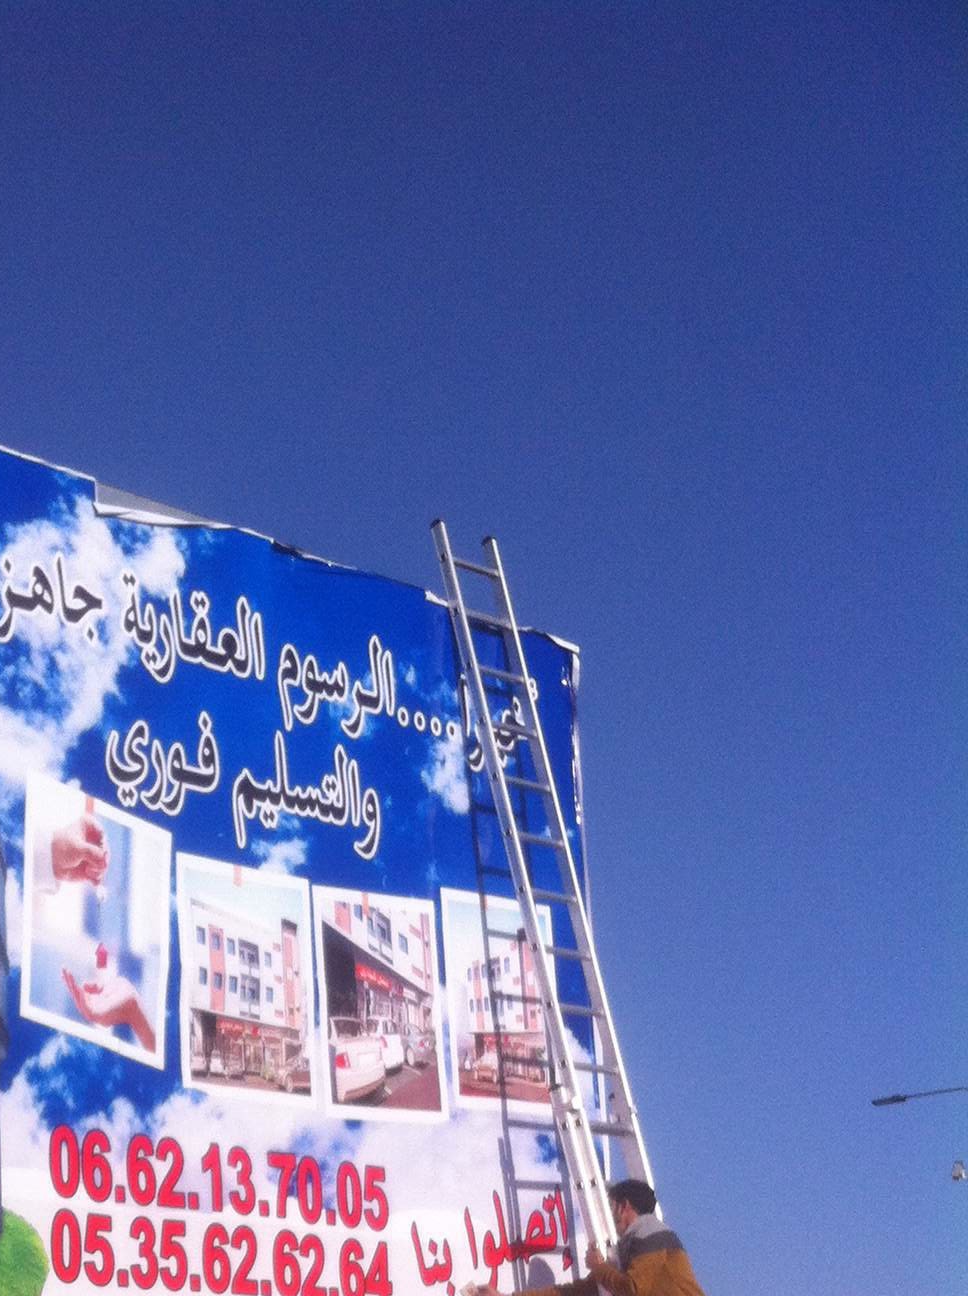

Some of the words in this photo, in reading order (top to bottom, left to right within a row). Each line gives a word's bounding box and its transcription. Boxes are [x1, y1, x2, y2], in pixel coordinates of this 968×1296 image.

[121, 570, 266, 684] العقارية
[106, 710, 220, 815] فوري
[232, 730, 382, 860] والتسليم
[48, 1124, 389, 1232] 06.62.13.70.05
